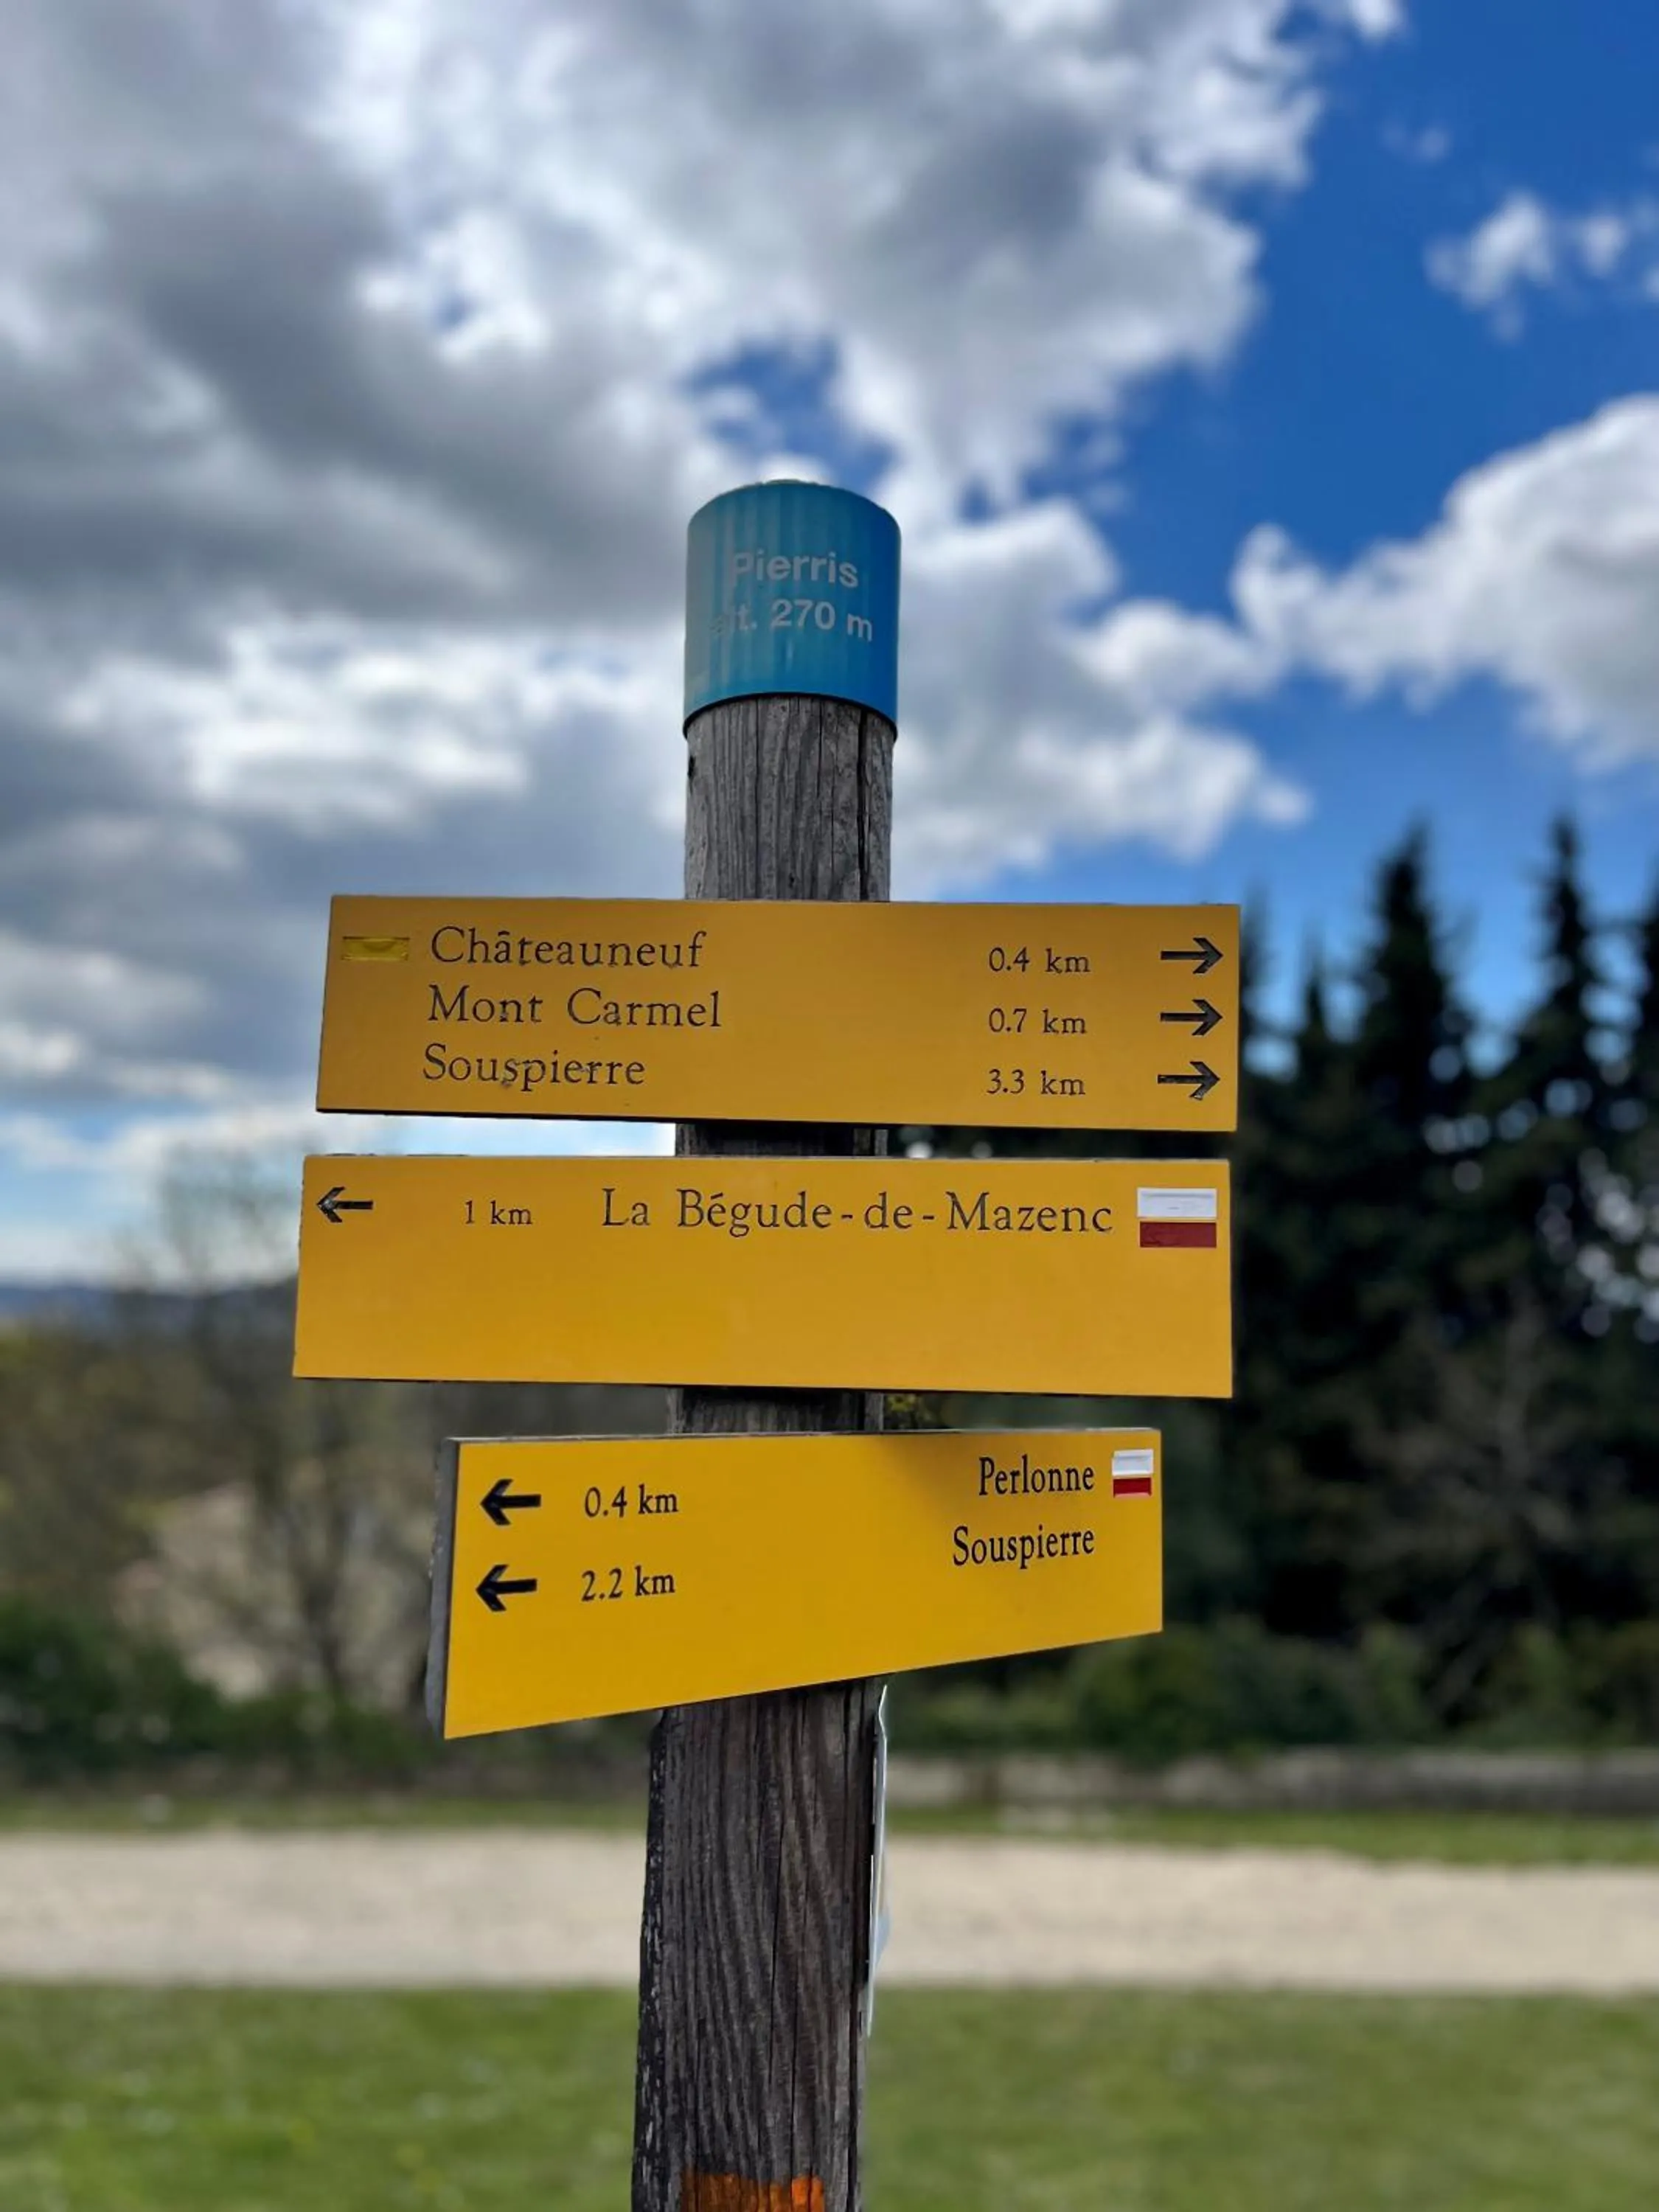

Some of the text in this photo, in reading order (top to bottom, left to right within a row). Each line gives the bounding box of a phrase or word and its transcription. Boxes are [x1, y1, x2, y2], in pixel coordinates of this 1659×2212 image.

[733, 549, 859, 588] Pierris
[771, 599, 835, 630] 270
[846, 613, 873, 642] m
[431, 925, 1091, 975] Châteauneuf 0.4 km
[428, 984, 1088, 1034] Mont Carmel 0.7 km
[422, 1043, 1086, 1096] Souspierre 3.3 km
[465, 1200, 475, 1225] 1
[490, 1200, 533, 1225] km
[601, 1188, 650, 1226] La
[584, 1453, 1094, 1518] 0.4 km Perlonne
[581, 1523, 1095, 1602] 2.2 km Souspierre
